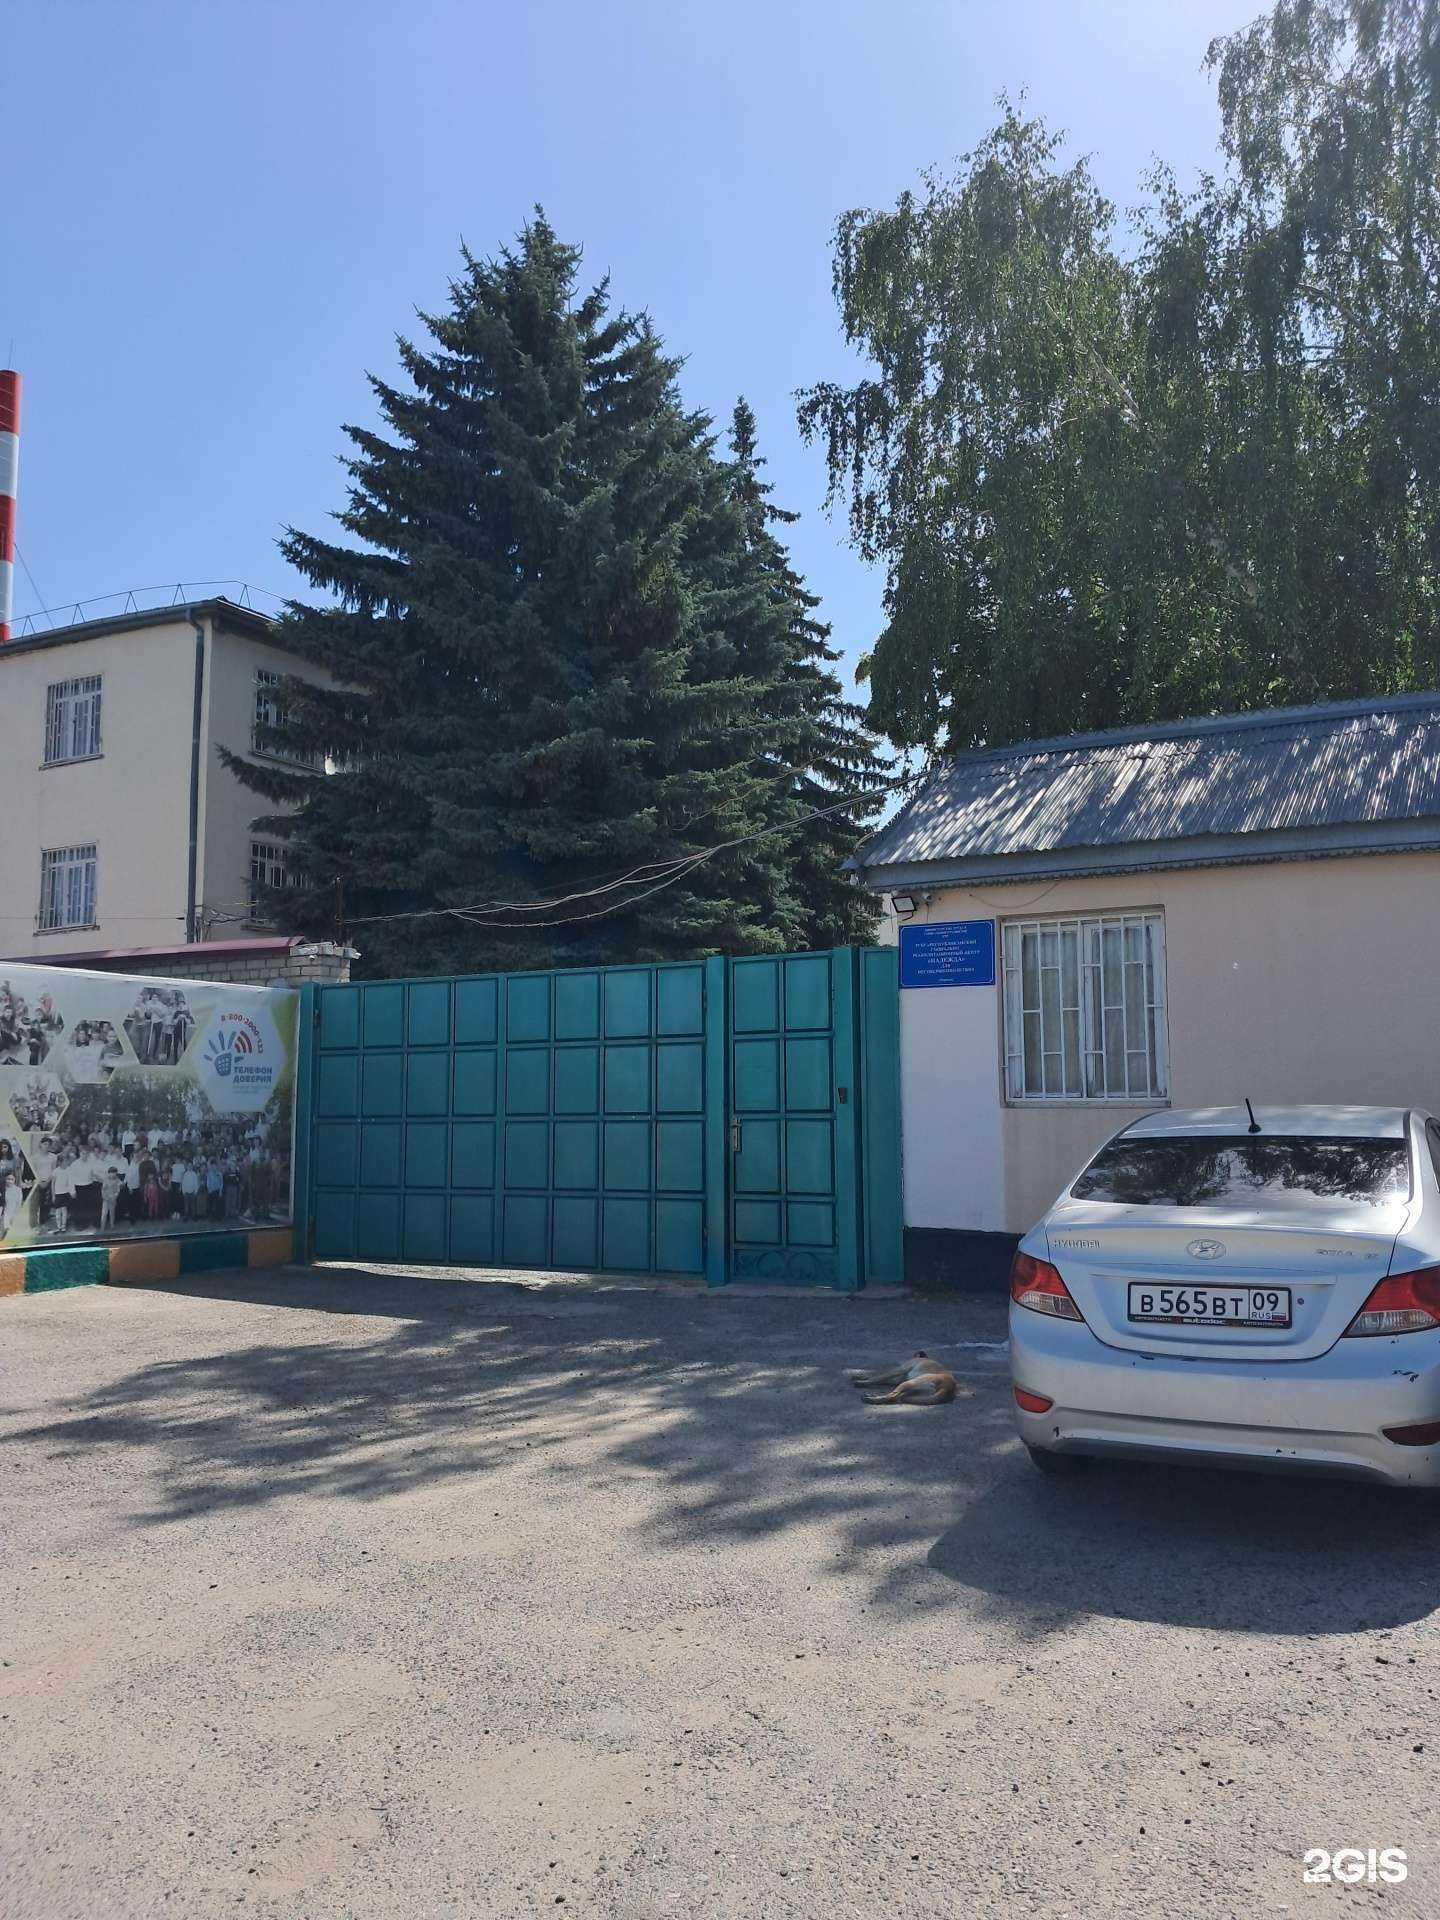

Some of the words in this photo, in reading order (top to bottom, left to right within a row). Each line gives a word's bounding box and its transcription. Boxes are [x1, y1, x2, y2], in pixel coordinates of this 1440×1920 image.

[233, 1066, 273, 1075] ТЕЛЕФОН
[233, 1075, 272, 1083] ДОВЕРИЯ
[1250, 1311, 1272, 1320] RUS
